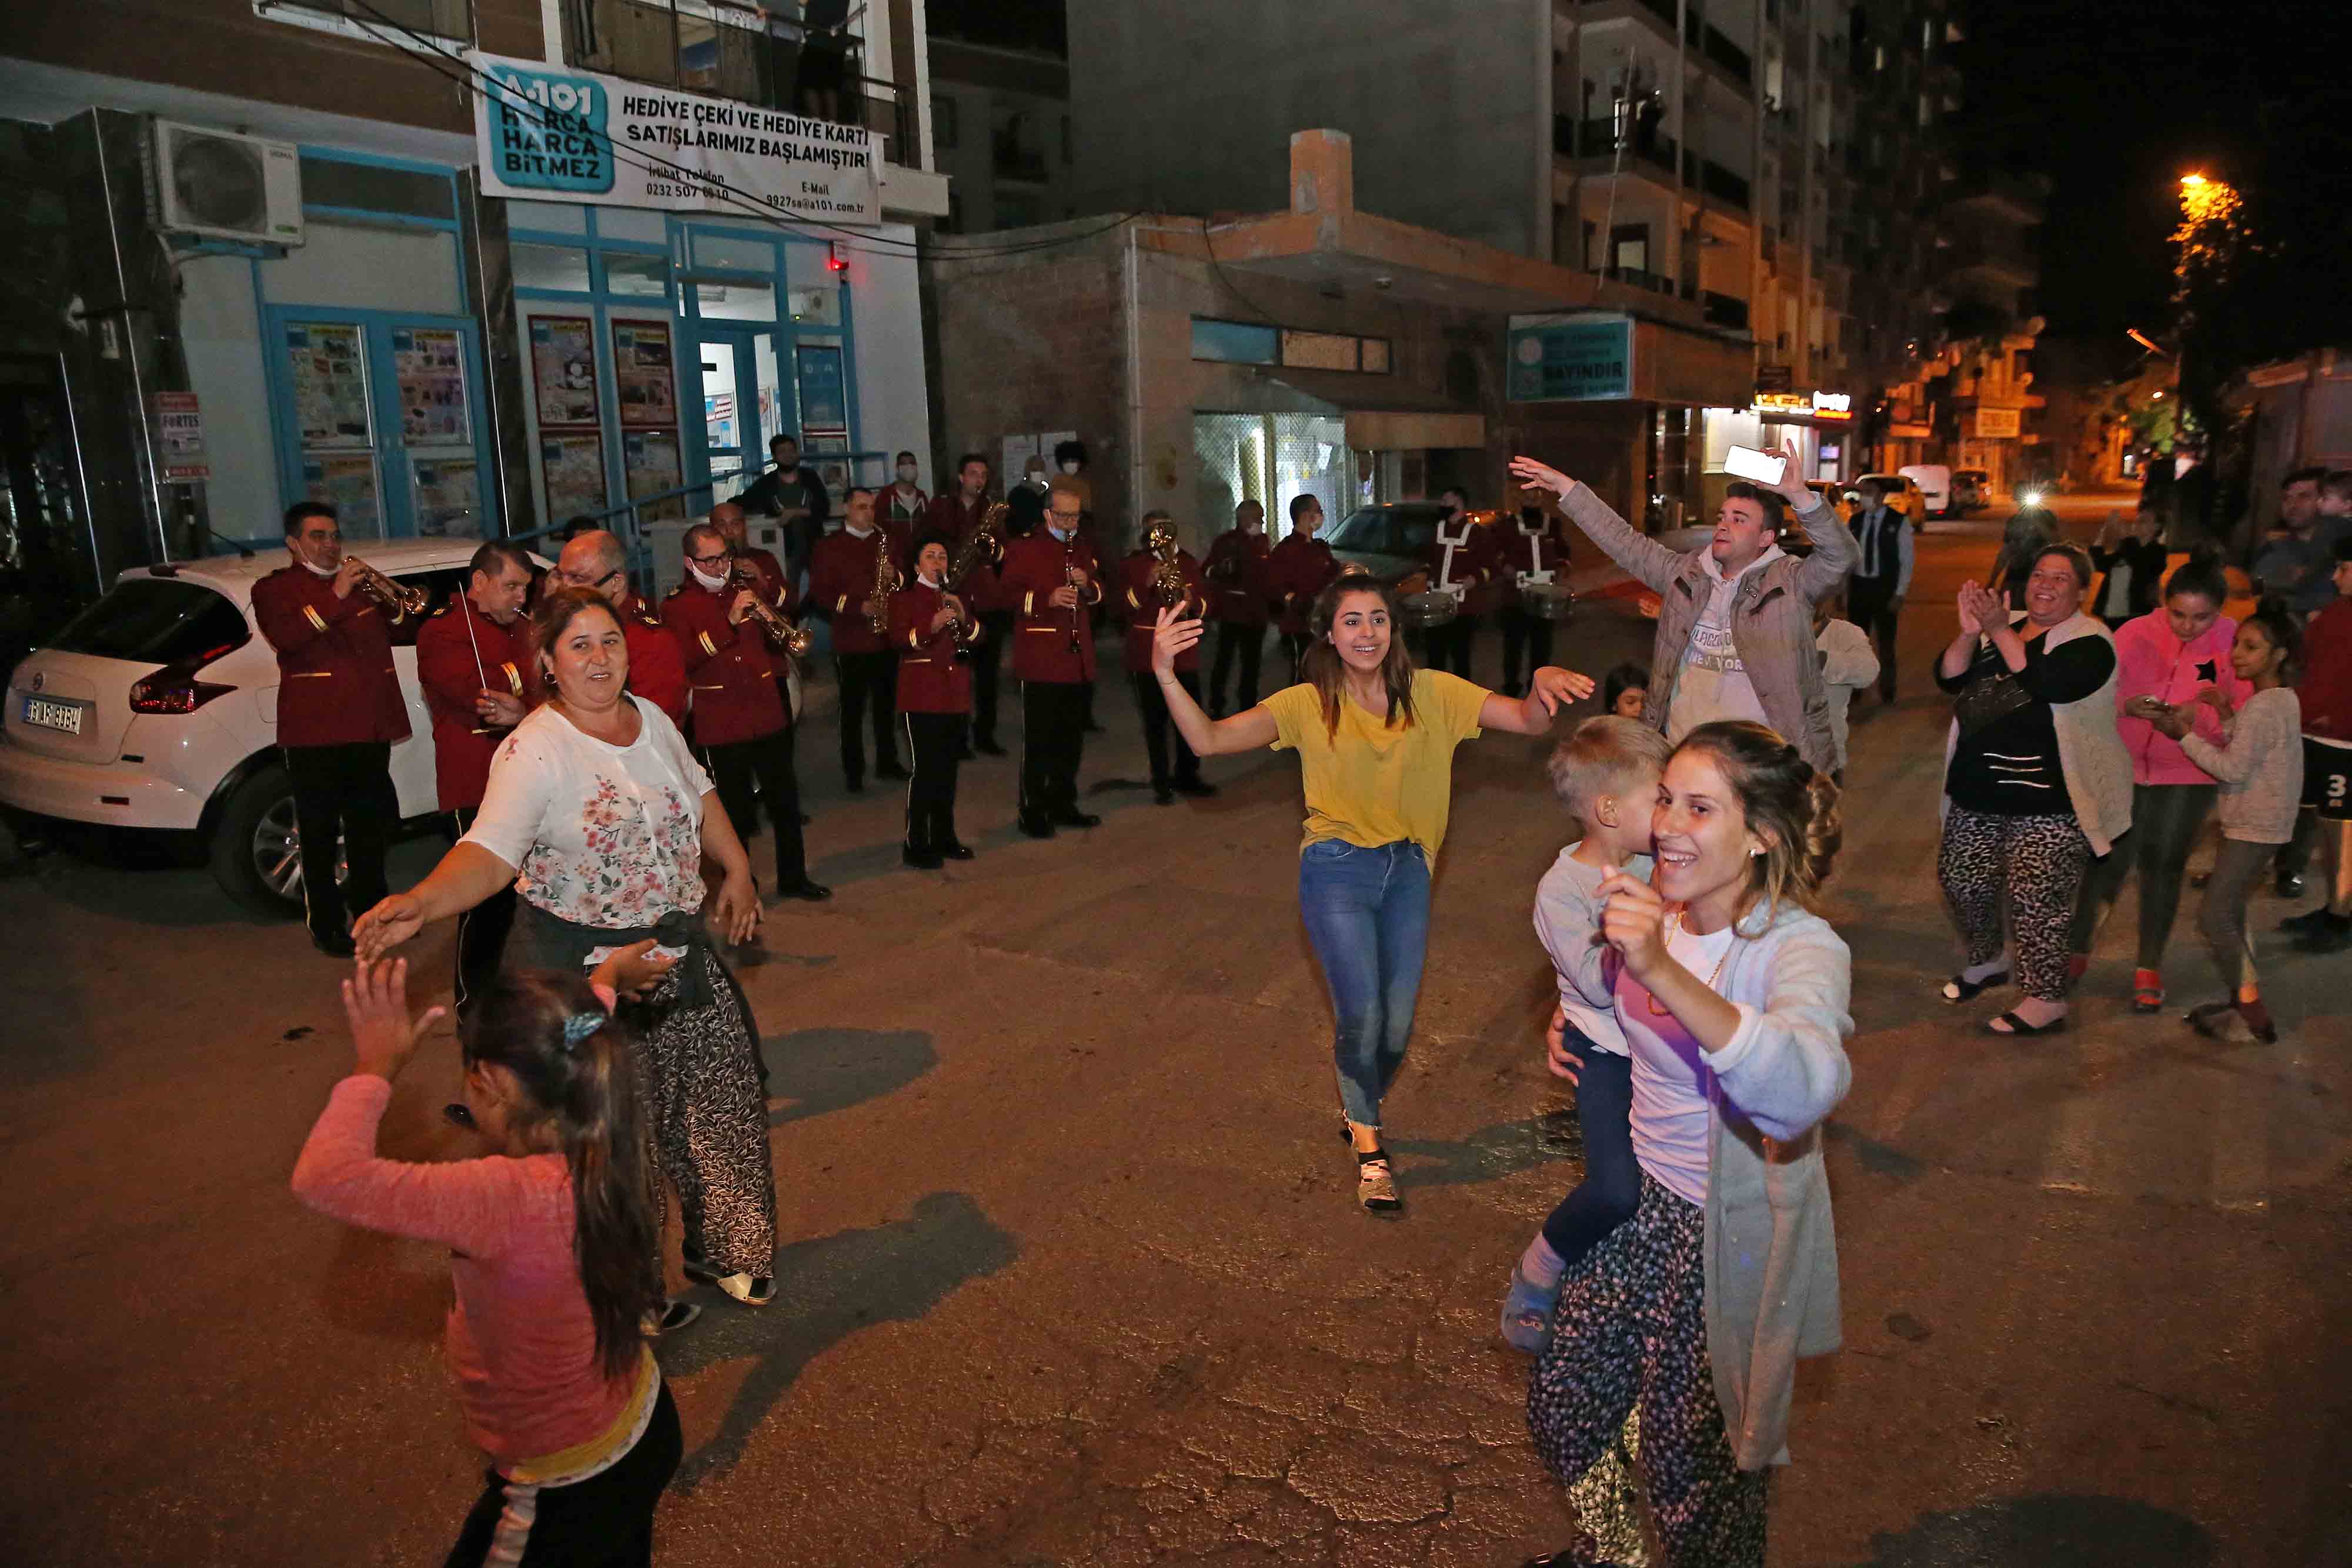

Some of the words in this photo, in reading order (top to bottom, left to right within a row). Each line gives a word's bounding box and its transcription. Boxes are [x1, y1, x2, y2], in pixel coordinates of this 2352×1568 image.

[502, 103, 592, 134] HRCA
[623, 95, 689, 119] HEDİYE
[694, 105, 733, 126] ÇEKİ
[738, 111, 760, 129] VE
[764, 113, 821, 139] HEDİYE
[826, 124, 868, 146] KARTI
[503, 128, 598, 156] HARCA
[627, 124, 756, 154] SATIŞLARIMIZ
[759, 139, 870, 170] BAŞLAMIŞTIR!
[647, 183, 671, 196] 0232
[676, 185, 697, 198] 507
[801, 181, 830, 195] E-Mail
[2326, 774, 2347, 797] 3
